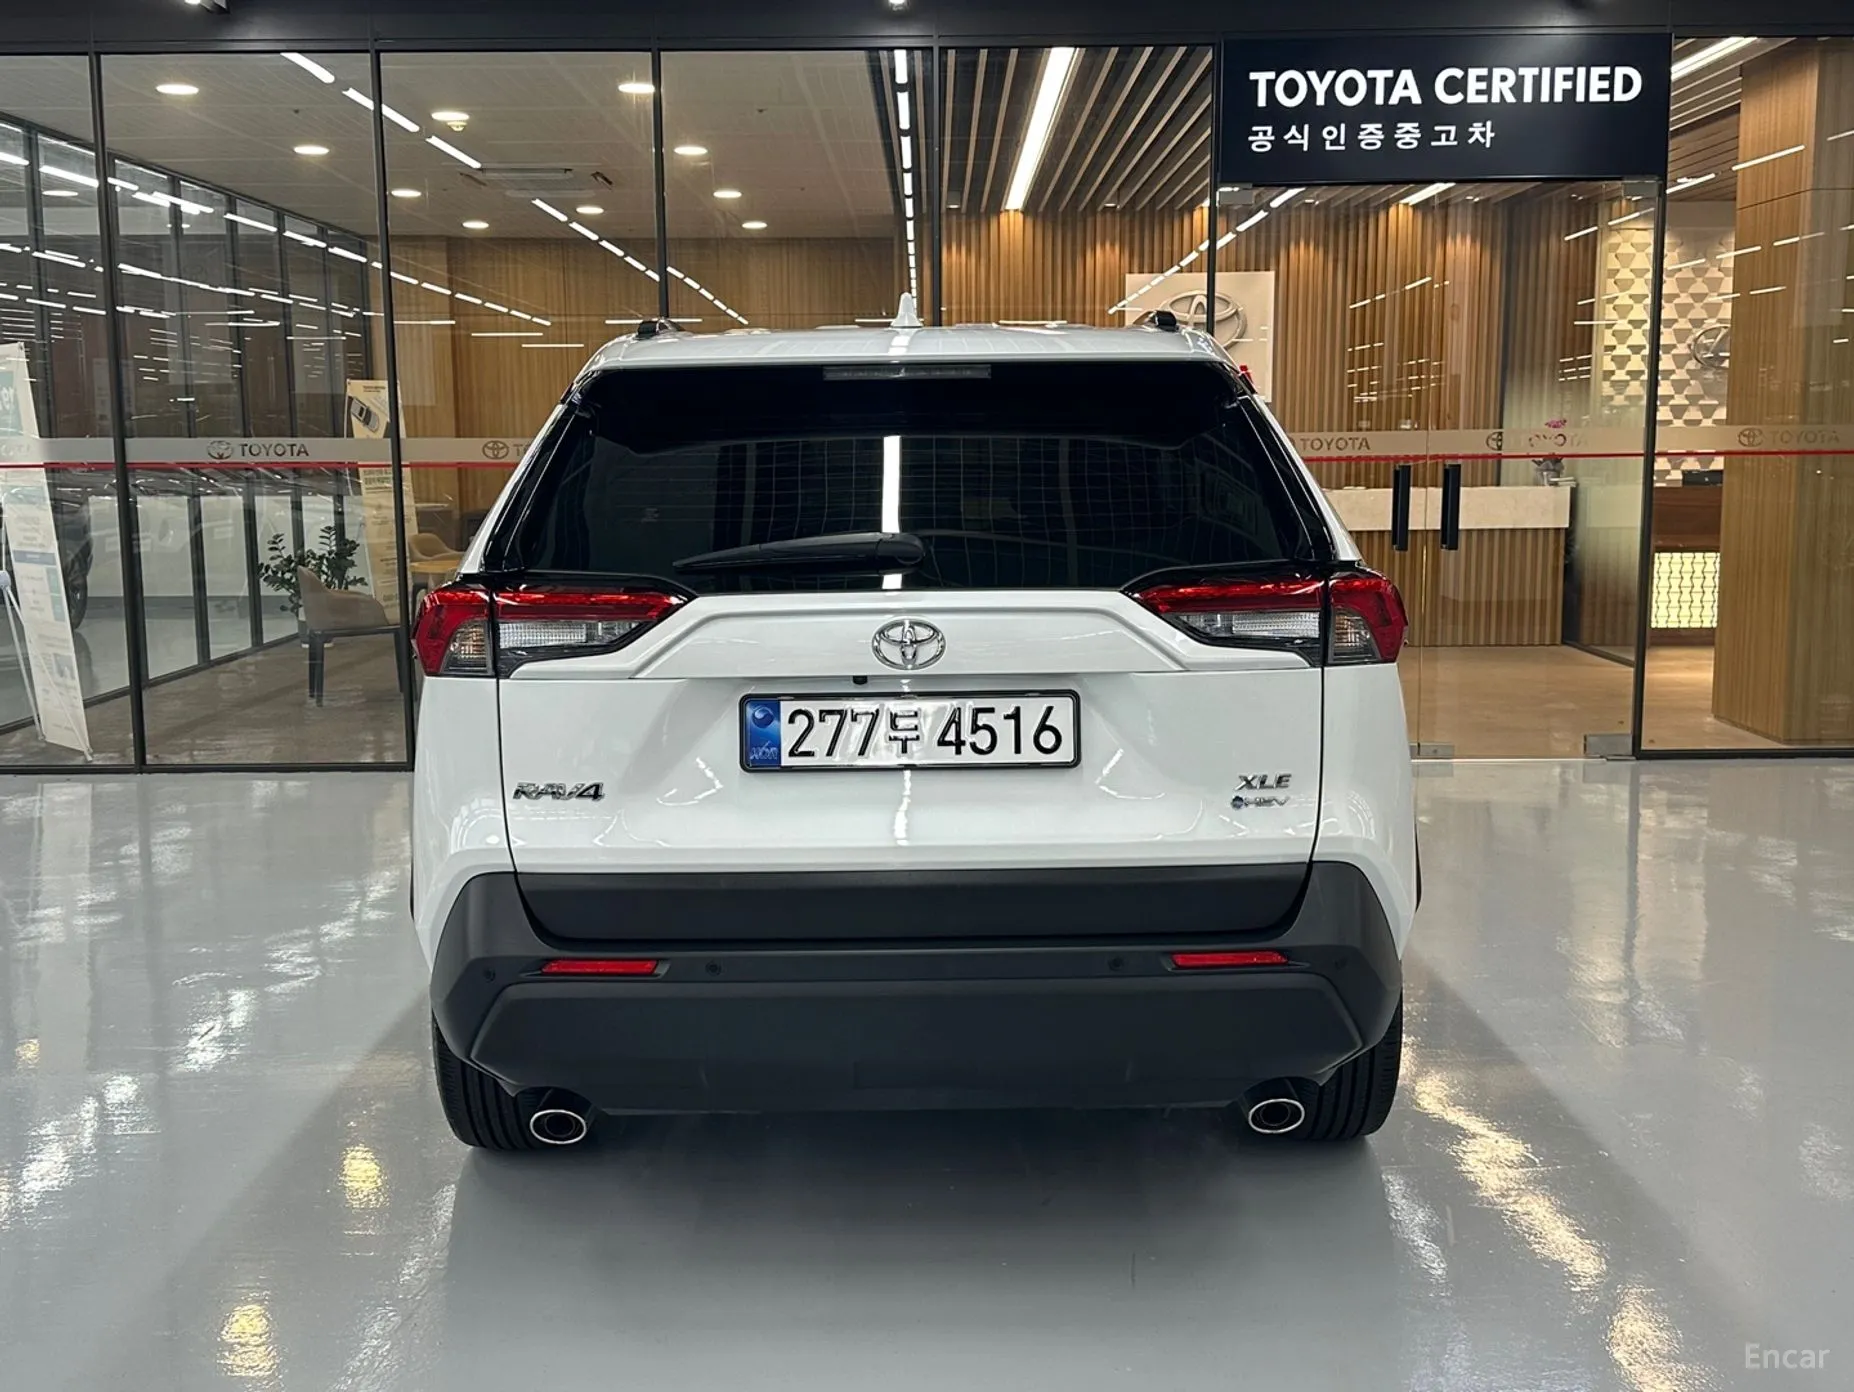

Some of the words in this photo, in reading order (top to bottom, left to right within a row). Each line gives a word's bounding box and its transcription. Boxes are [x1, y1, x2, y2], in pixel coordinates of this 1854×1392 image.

[1249, 69, 1422, 107] TOYOTA
[1434, 65, 1642, 105] CERTIFIED
[1247, 120, 1496, 152] 공식인증중고차
[1300, 437, 1371, 451] TOYOTA
[1769, 430, 1841, 445] TOYOTA
[239, 443, 310, 457] TOYOTA
[787, 708, 921, 758] 277두
[936, 706, 1064, 755] 4516
[1233, 774, 1292, 790] XLE
[513, 782, 605, 801] RAV4
